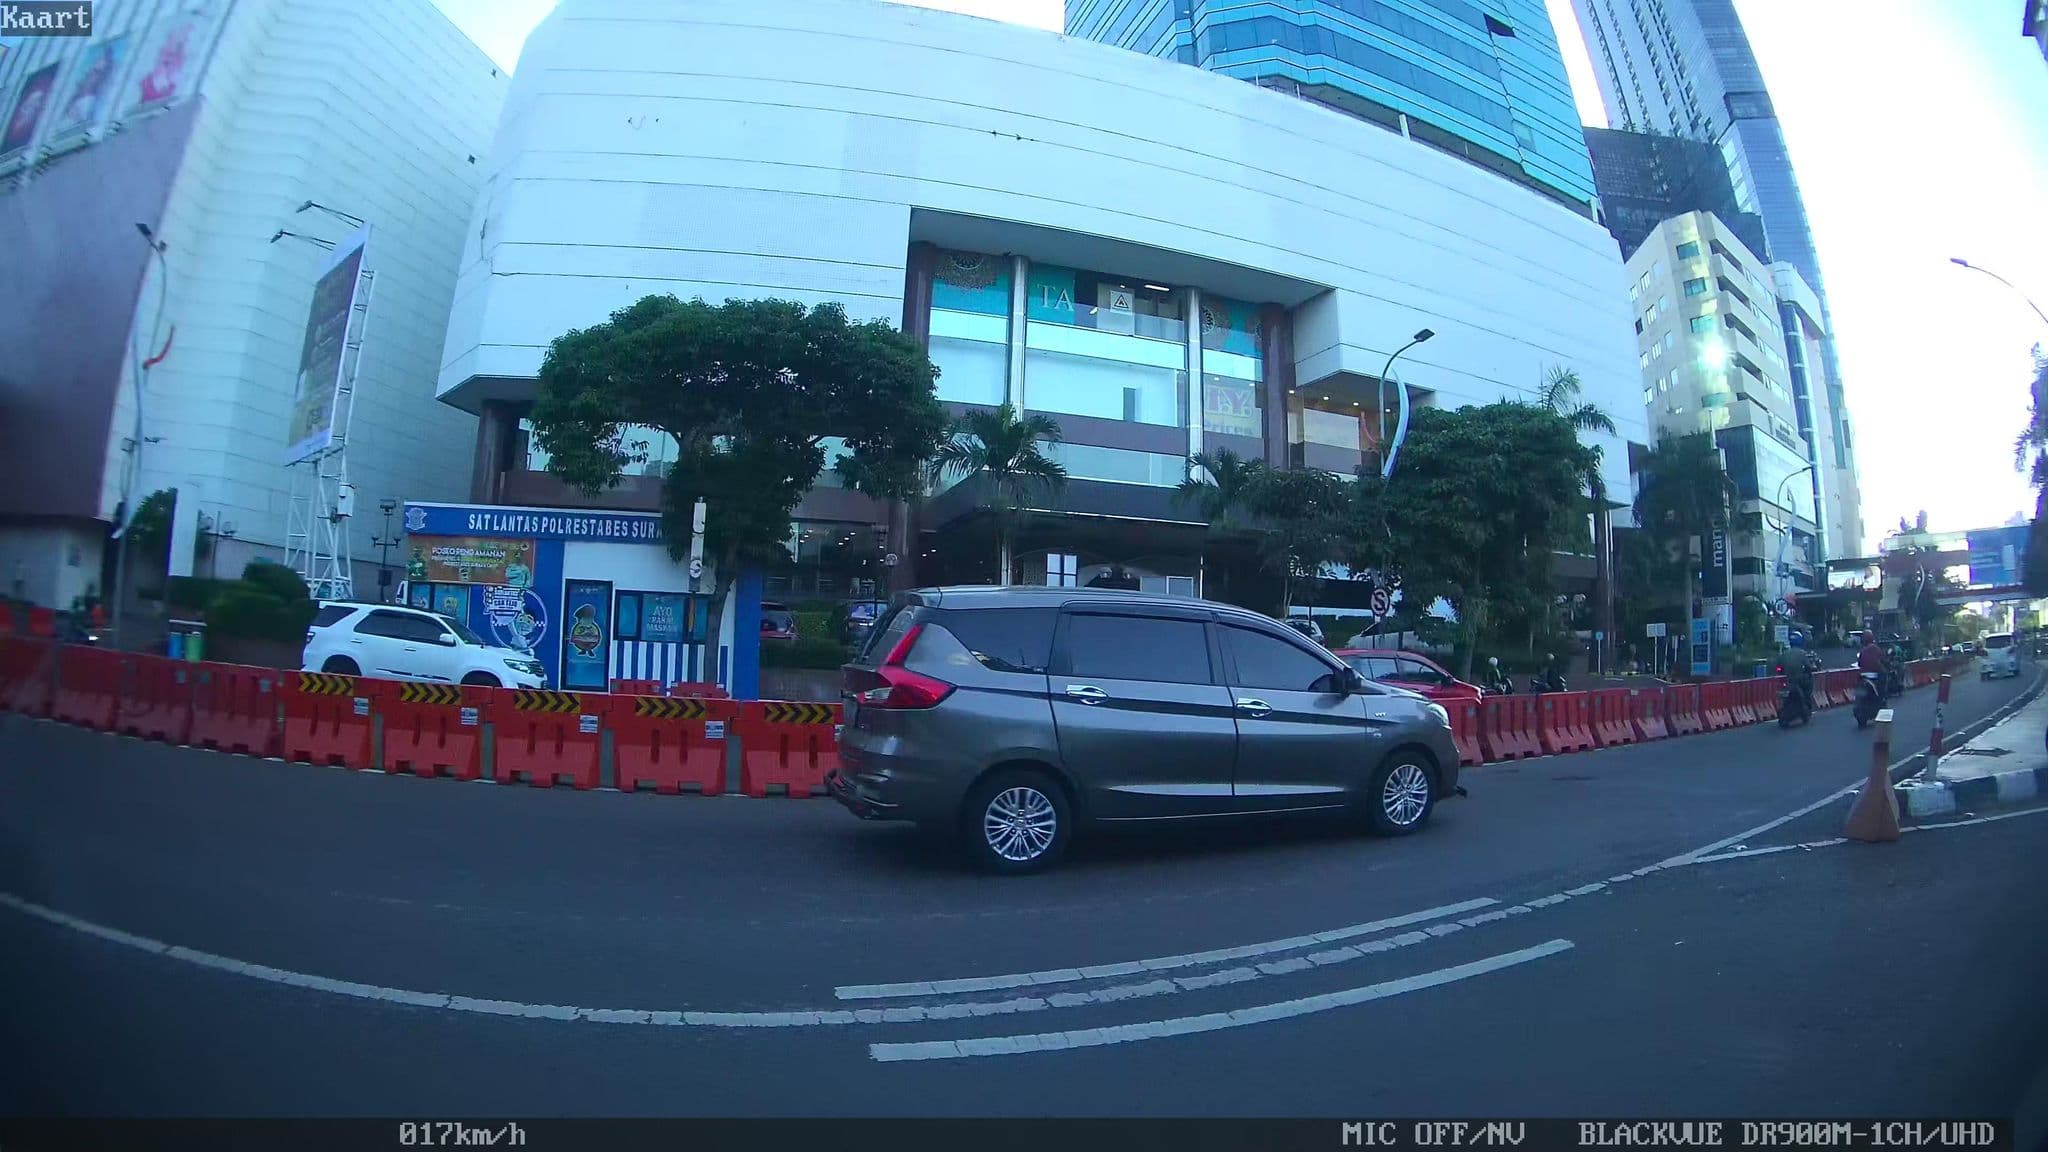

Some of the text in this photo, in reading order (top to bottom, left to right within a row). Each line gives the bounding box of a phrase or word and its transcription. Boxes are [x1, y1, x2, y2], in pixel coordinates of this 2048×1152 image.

[1037, 284, 1075, 312] TA
[468, 513, 491, 531] SAT
[493, 514, 538, 533] LANTAS
[541, 517, 628, 537] POLRESTABES
[652, 605, 672, 616] AYO
